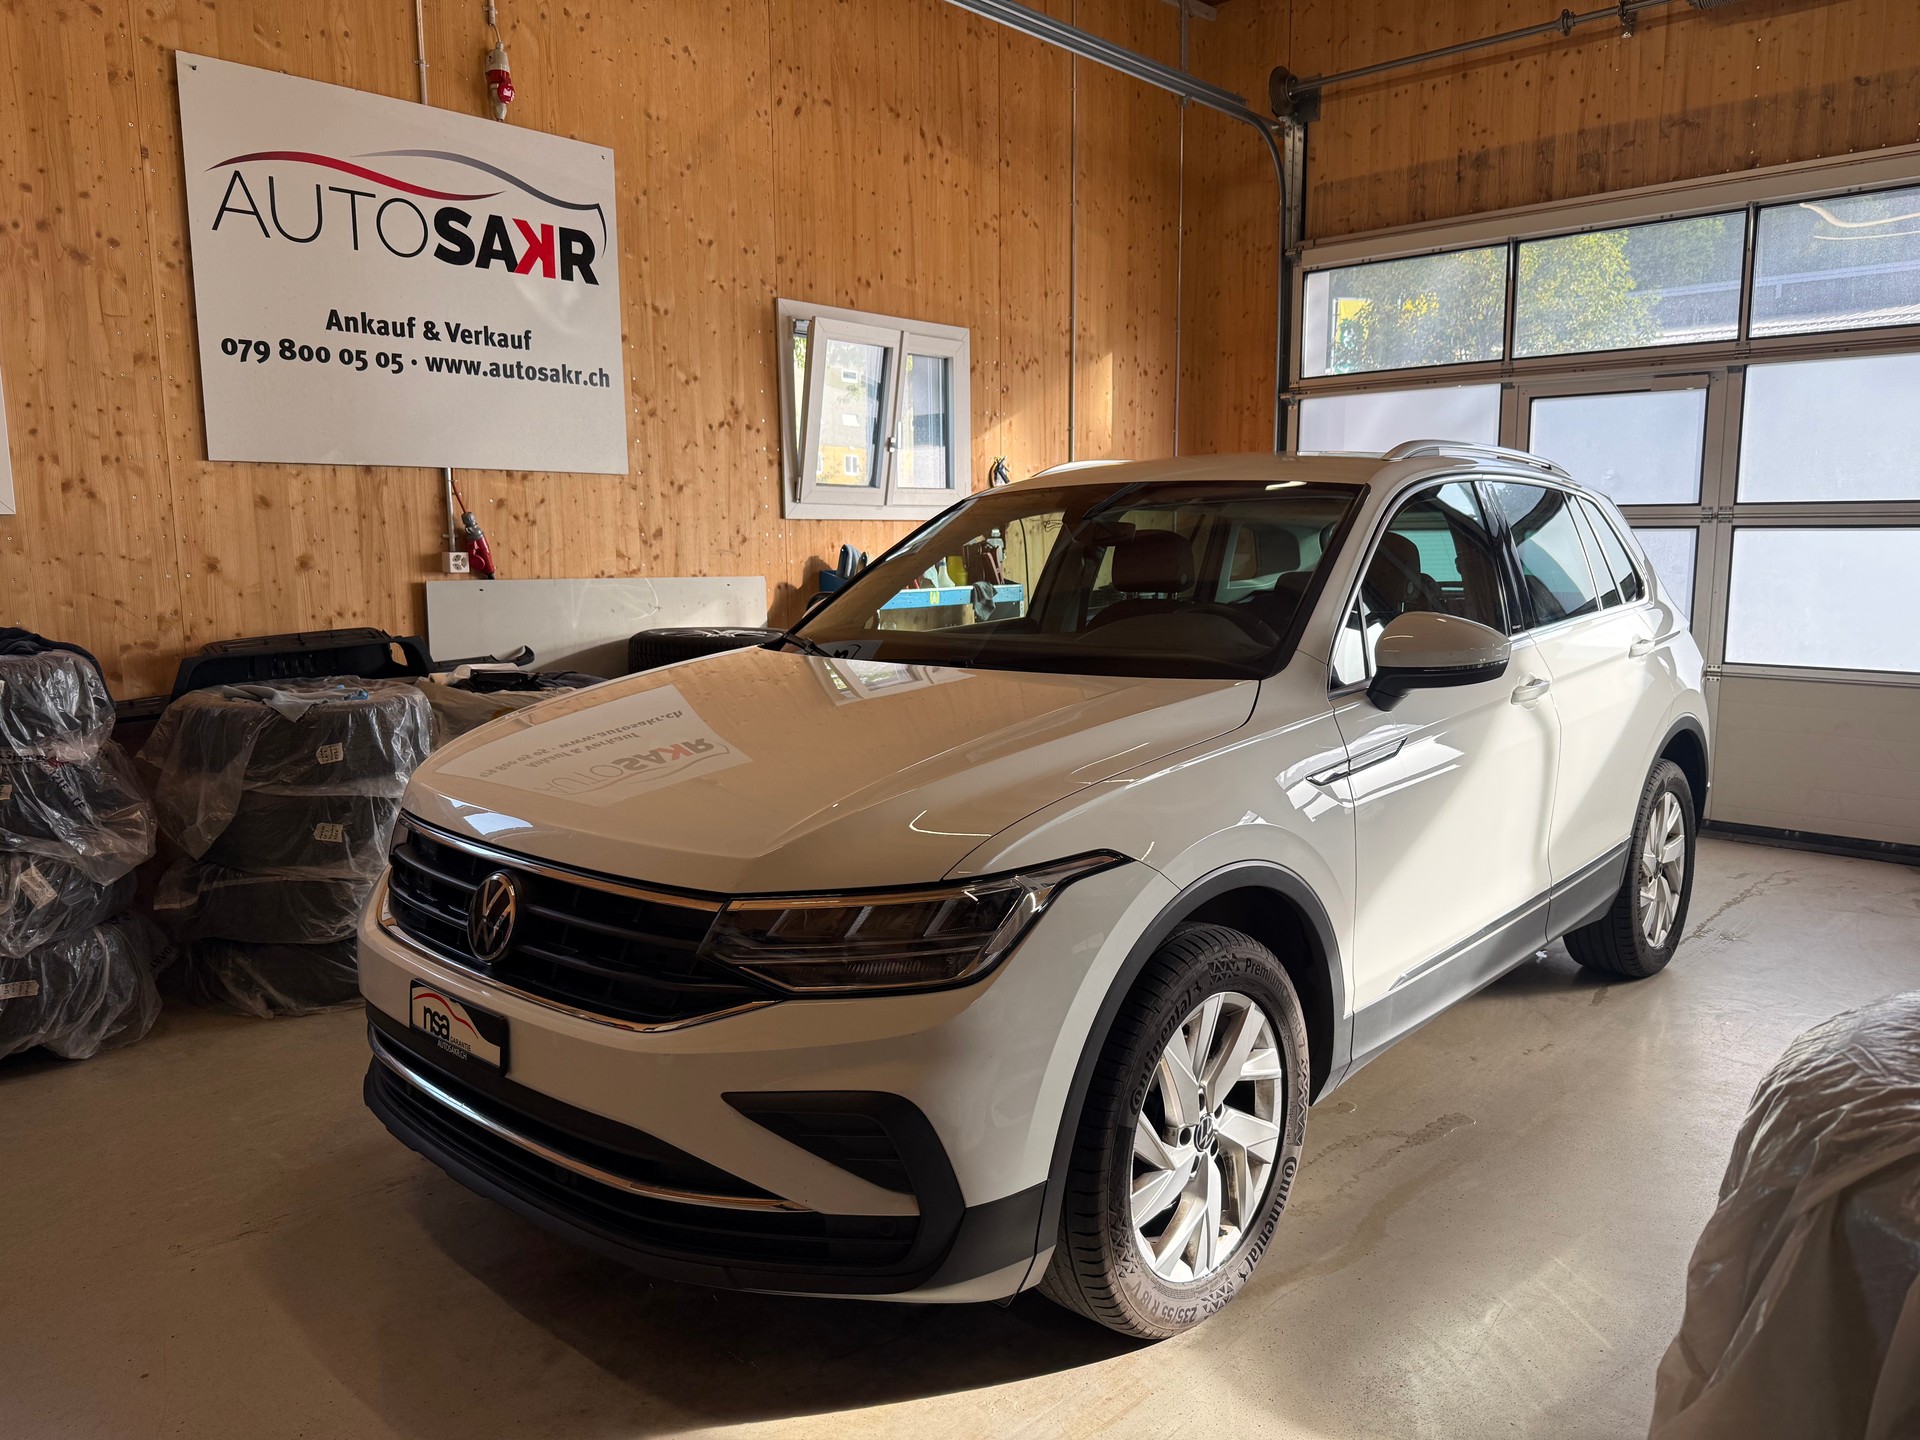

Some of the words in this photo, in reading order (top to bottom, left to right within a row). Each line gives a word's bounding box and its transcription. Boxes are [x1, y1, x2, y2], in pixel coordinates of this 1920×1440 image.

[211, 169, 600, 286] AUTOSAKR
[325, 309, 416, 339] Ankauf
[422, 320, 442, 342] &
[444, 321, 532, 351] Verkauf
[221, 336, 271, 364] 079
[278, 338, 331, 364] 800
[338, 349, 368, 372] 05
[375, 352, 404, 375] 05
[425, 356, 611, 388] www.autosakr.ch
[423, 1006, 450, 1041] nsa
[1129, 988, 1192, 1116] Continental
[1244, 1156, 1298, 1272] Continental
[1150, 1301, 1160, 1316] R
[1161, 1304, 1198, 1325] 235/55
